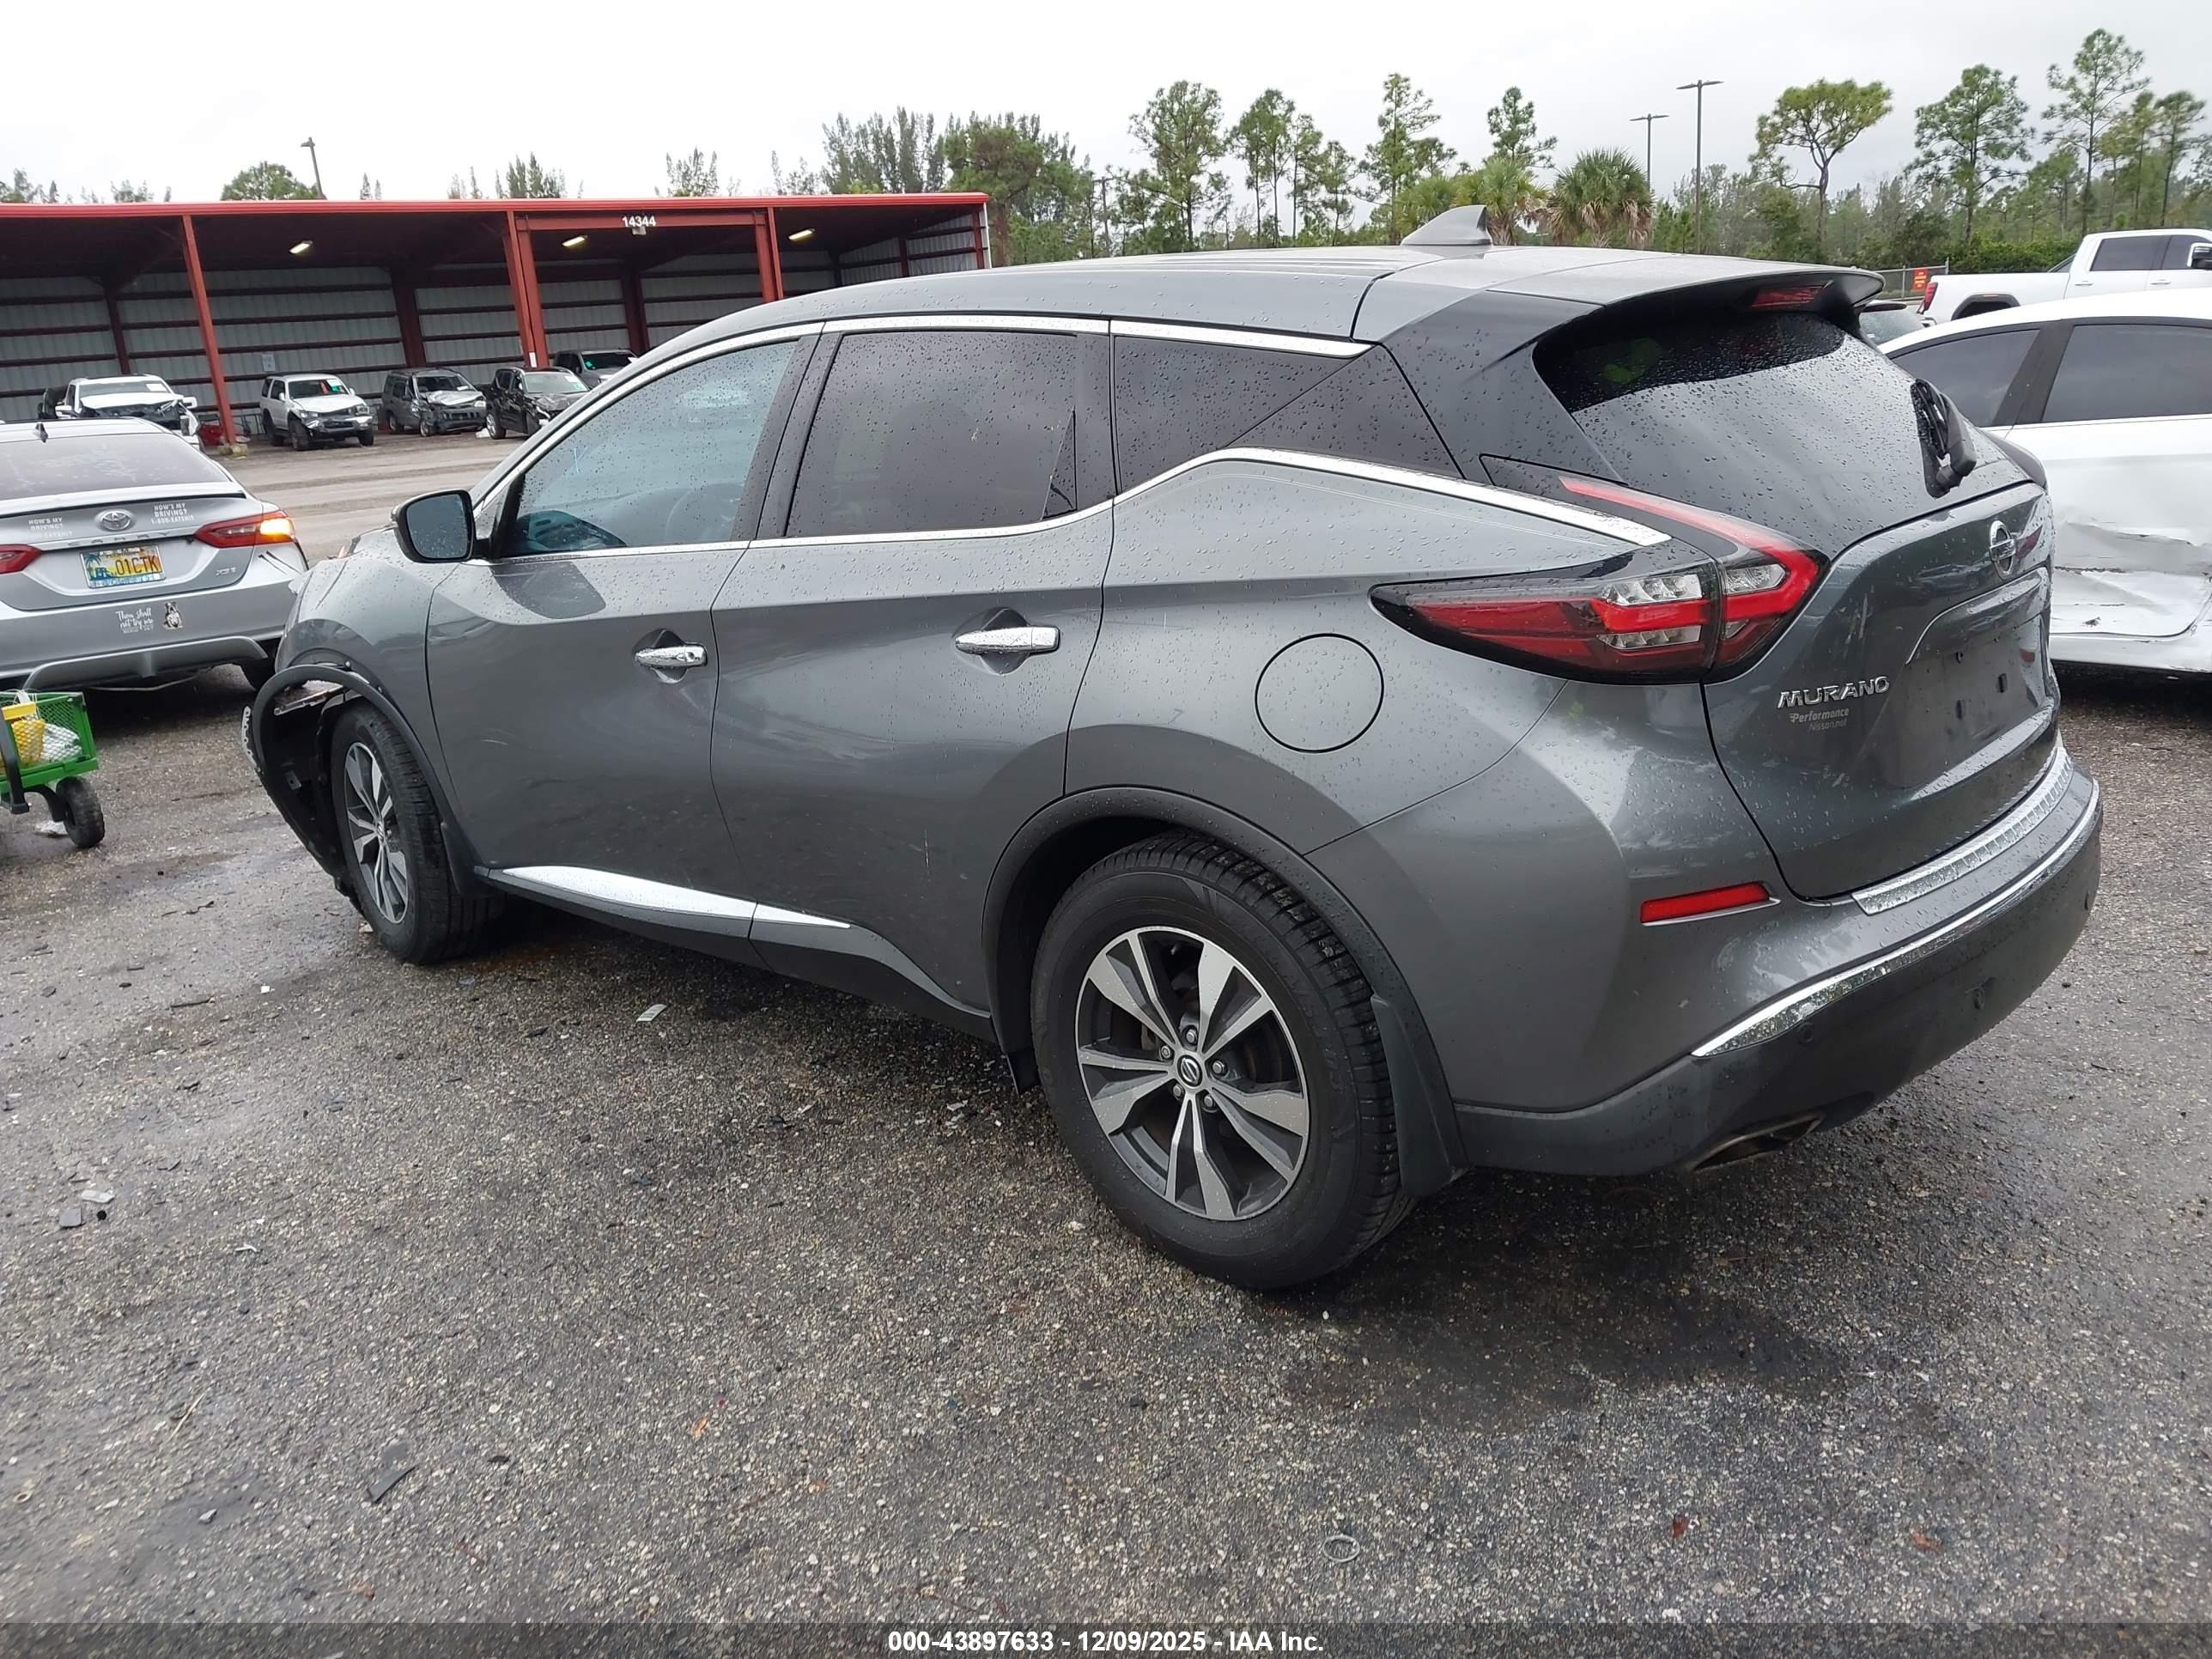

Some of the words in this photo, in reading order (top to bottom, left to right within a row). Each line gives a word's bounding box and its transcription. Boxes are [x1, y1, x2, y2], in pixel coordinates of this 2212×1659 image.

[622, 216, 657, 228] 14344
[154, 508, 187, 518] DRIVING?
[1777, 676, 1890, 708] MURANO
[1790, 708, 1850, 723] Performance
